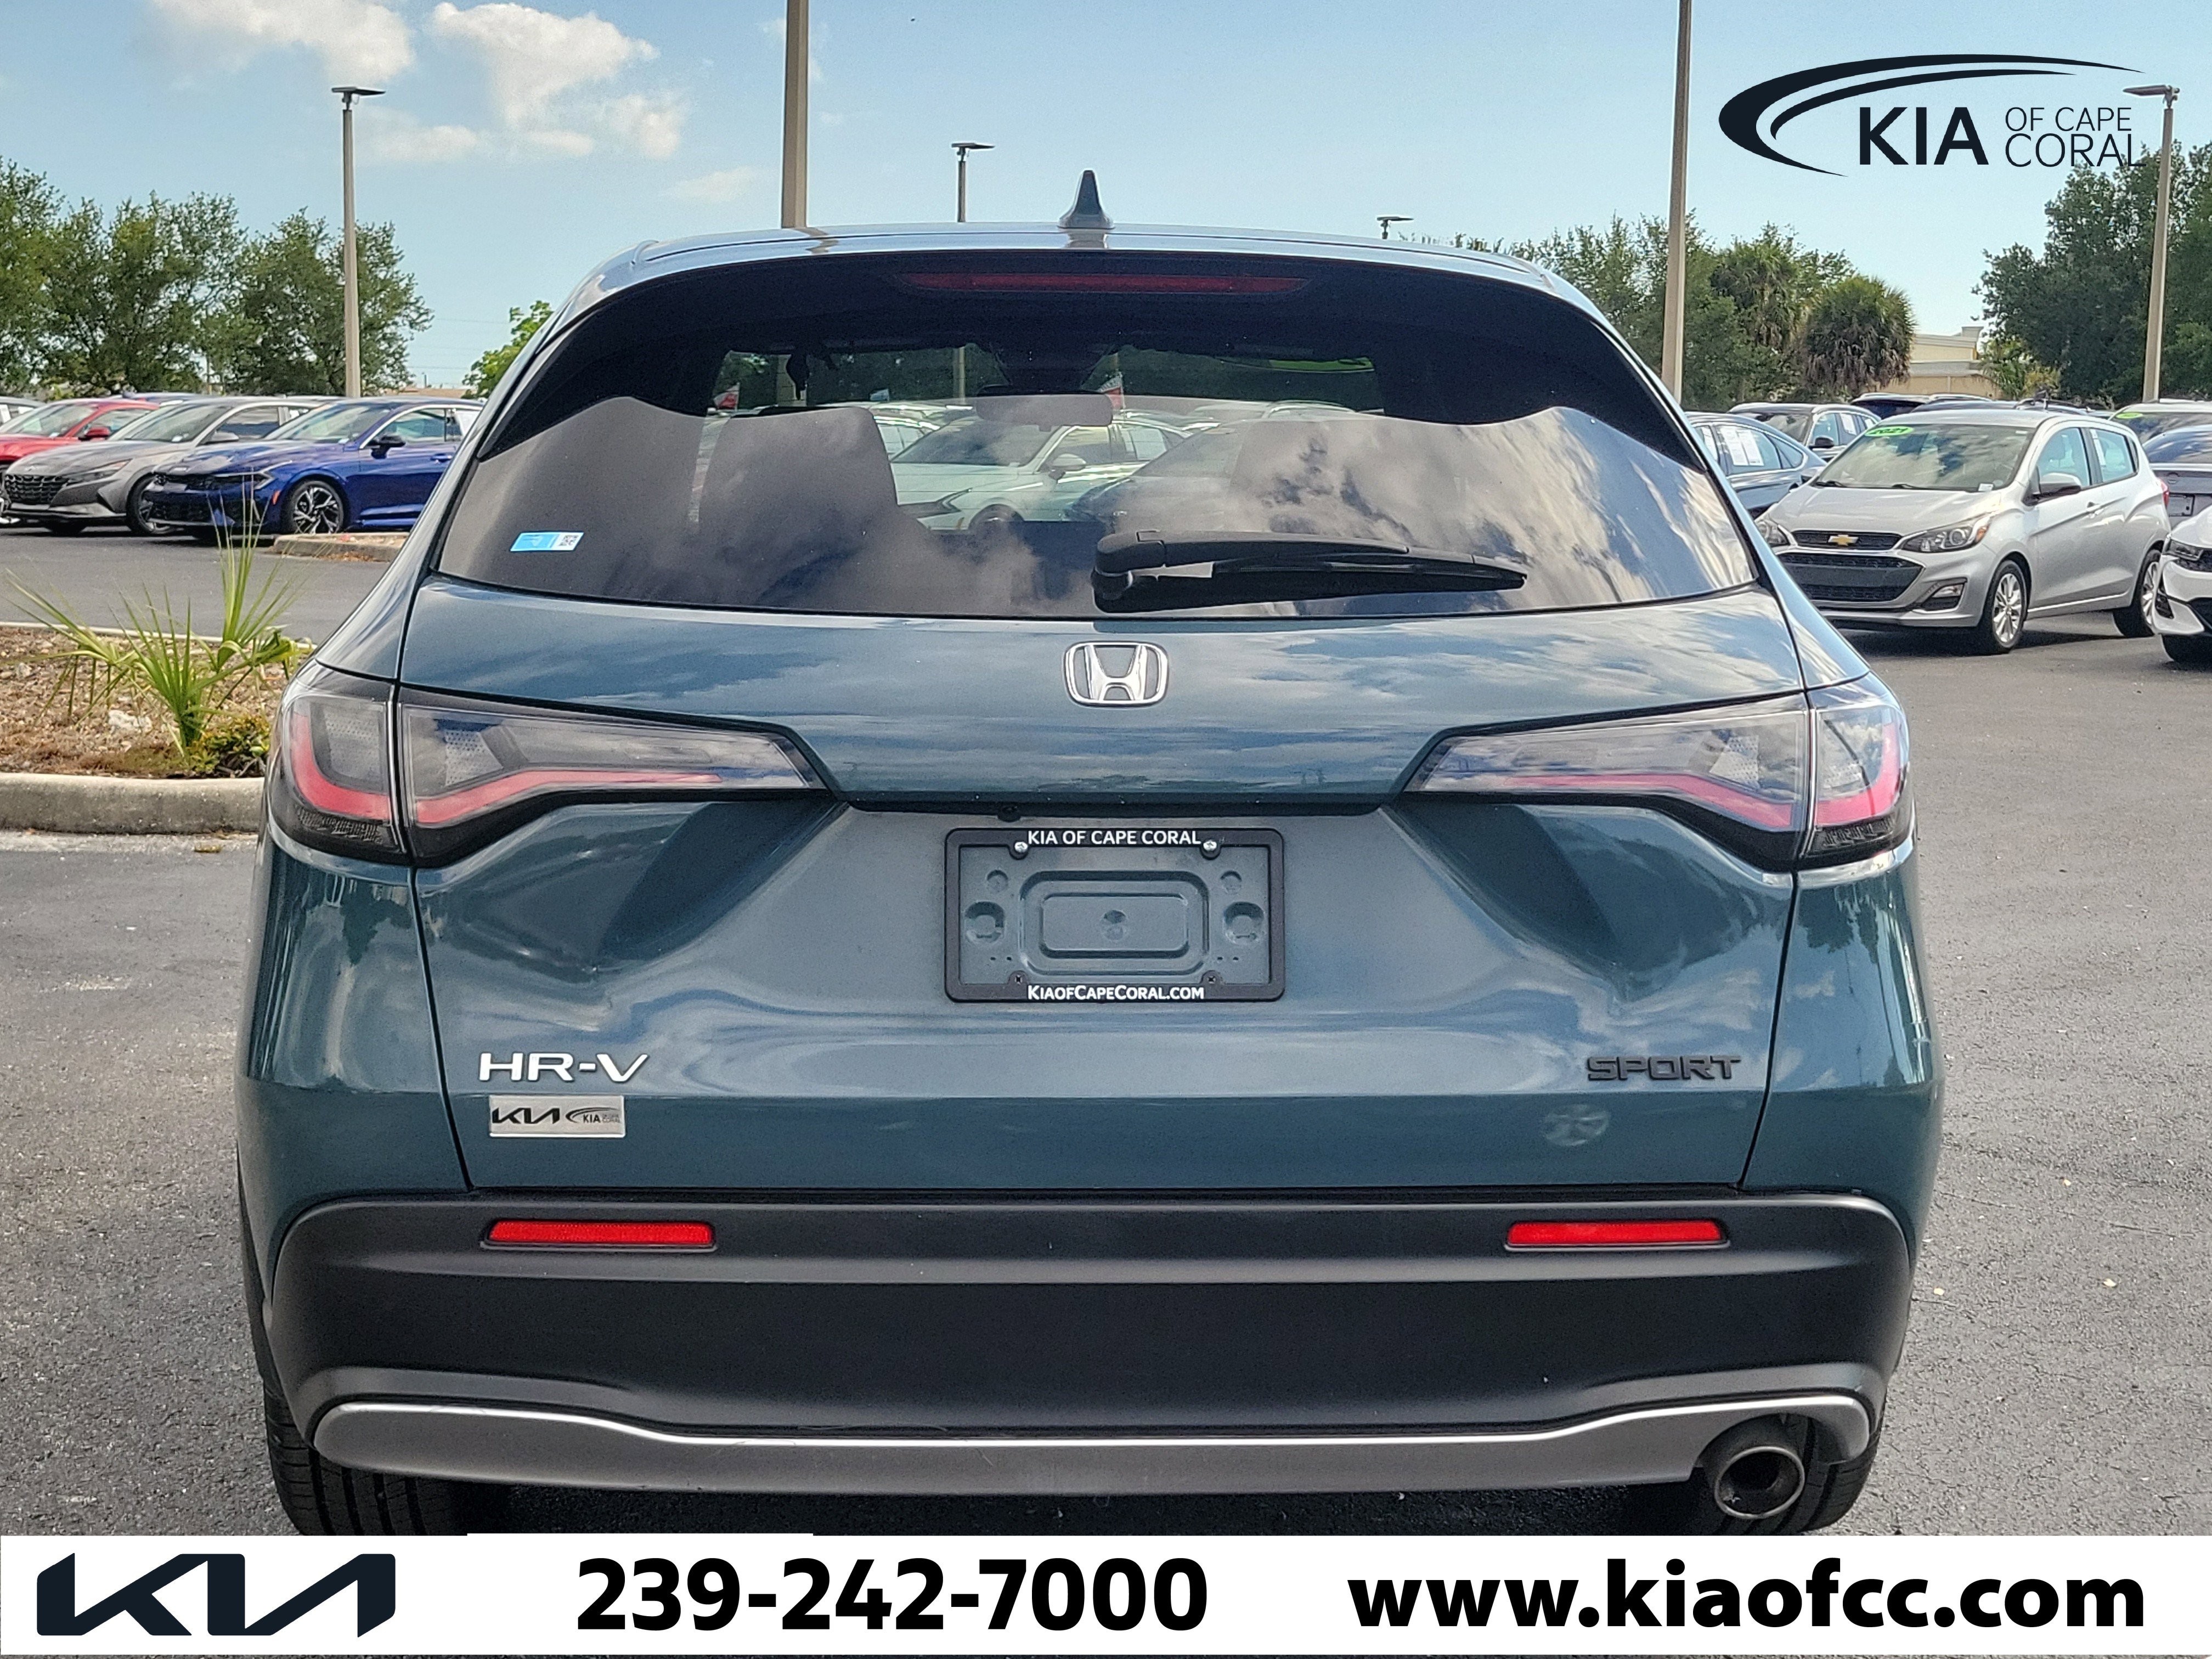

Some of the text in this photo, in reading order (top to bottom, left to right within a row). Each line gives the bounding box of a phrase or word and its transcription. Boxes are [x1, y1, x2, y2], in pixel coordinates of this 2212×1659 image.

[1028, 831, 1201, 845] KIA OF CAPE CORAL
[479, 1052, 650, 1082] HR-V
[1587, 1054, 1741, 1081] SPORT
[583, 1114, 601, 1123] KIA
